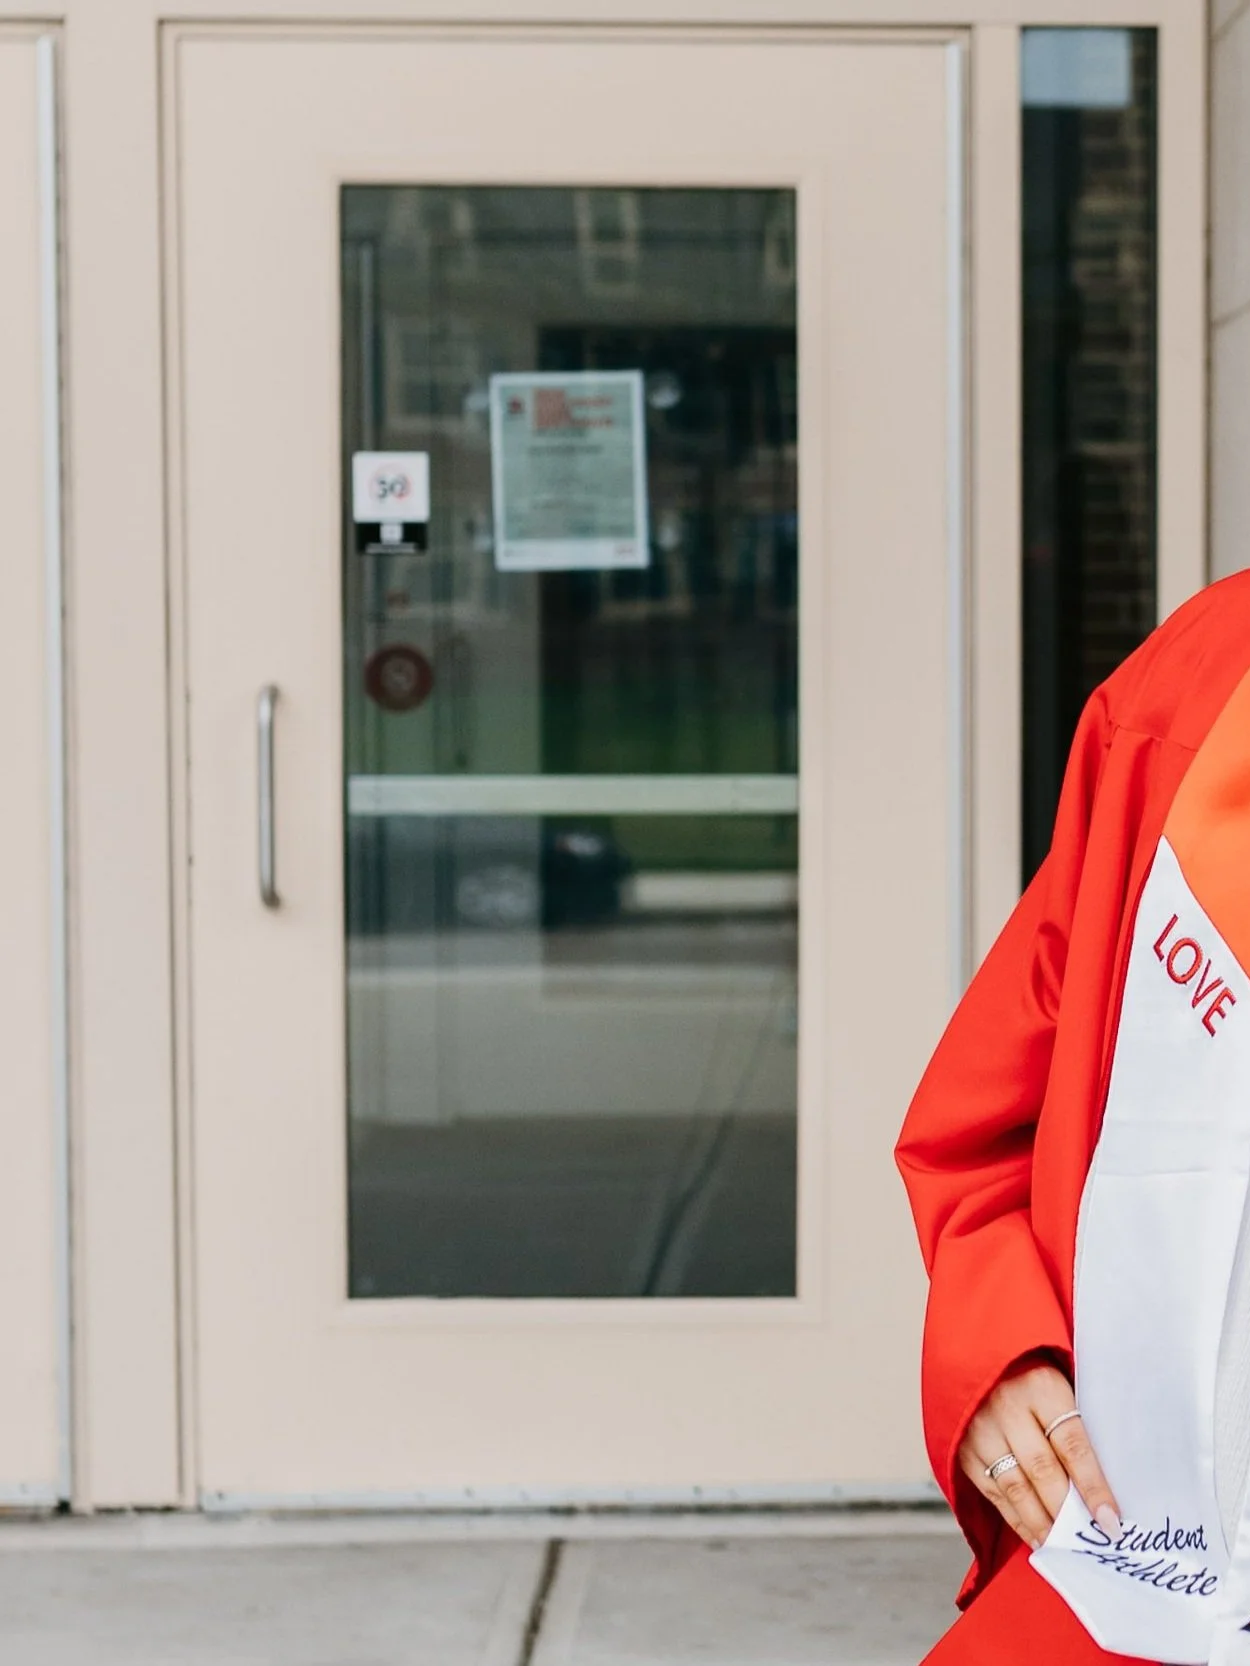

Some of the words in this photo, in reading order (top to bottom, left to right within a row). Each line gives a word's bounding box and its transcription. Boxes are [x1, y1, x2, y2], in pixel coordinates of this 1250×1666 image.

[1152, 913, 1236, 1038] LOVE
[1075, 1515, 1209, 1551] Student
[1071, 1549, 1218, 1597] Athlete
